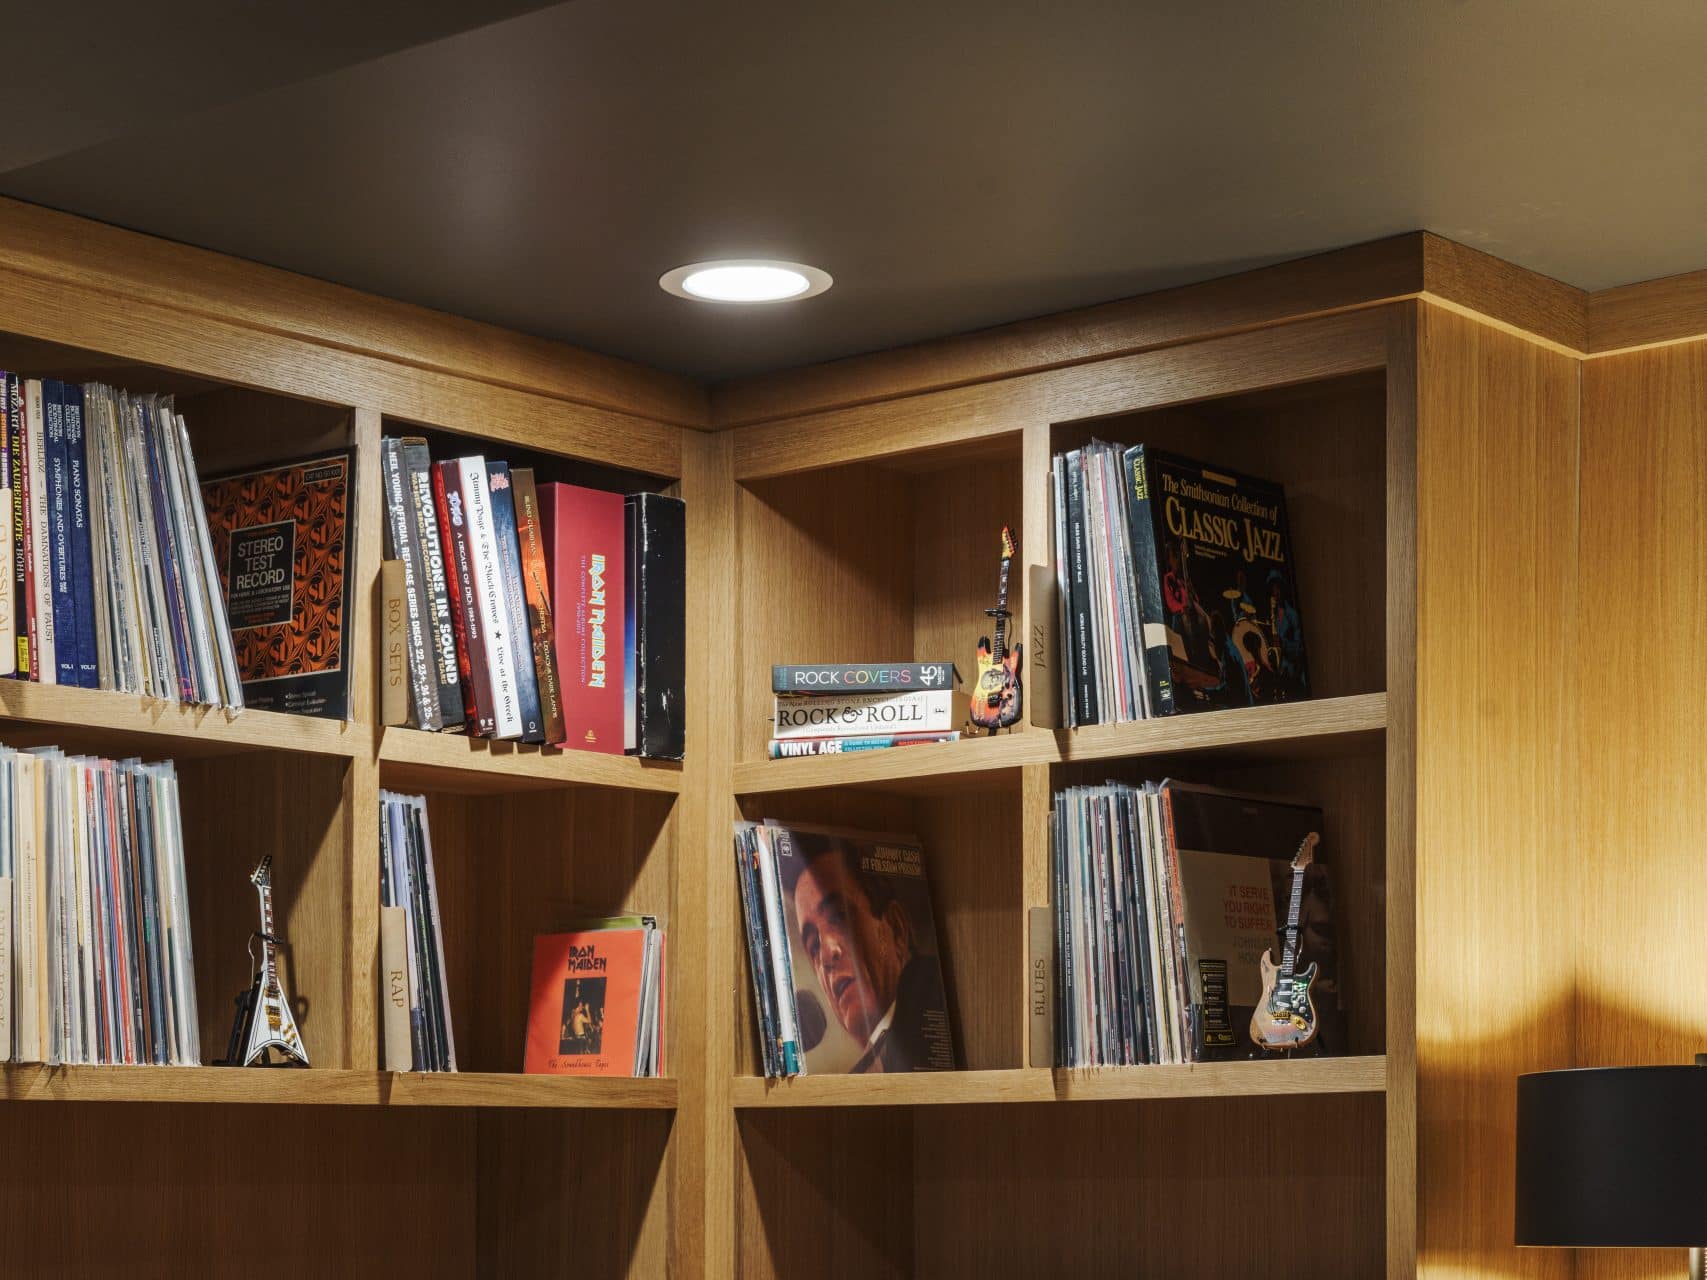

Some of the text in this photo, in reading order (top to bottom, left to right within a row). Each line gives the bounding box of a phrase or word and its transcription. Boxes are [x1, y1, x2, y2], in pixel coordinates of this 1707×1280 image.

[389, 451, 398, 472] NEIL
[10, 384, 25, 582] MOZART DIE ZAUBERFLÖTE BÖHM
[72, 460, 83, 528] PIANO SONATAS
[391, 472, 401, 503] YOUNG
[469, 472, 482, 505] Jimmy
[524, 495, 532, 518] BLIND
[1162, 473, 1180, 495] The
[1180, 477, 1230, 510] Smithsonian
[1231, 493, 1268, 518] Collection
[1268, 506, 1279, 526] of
[53, 457, 66, 581] SYMPHONIES AND OVERTURES
[395, 505, 408, 544] OFFICIAL
[473, 505, 486, 531] Page
[1165, 495, 1286, 564] CLASSIC JAZZ
[36, 432, 53, 644] BERLIOZ THE DAMNATIONS OF FAUST
[237, 535, 284, 559] STEREO
[527, 519, 537, 556] GUARDIAN
[245, 554, 276, 573] TEST
[457, 540, 468, 572] DECADE
[463, 573, 470, 585] OF
[481, 541, 491, 561] The
[236, 568, 285, 590] RECORD
[401, 546, 414, 586] RELEASE
[417, 472, 458, 685] REVOLUTIONS IN SOUND
[407, 587, 419, 618] SERIES
[429, 602, 438, 626] FIRST
[489, 590, 500, 624] Crowes
[411, 621, 423, 647] DISCS
[587, 554, 606, 688] IRON MAIDEN
[389, 599, 402, 687] BOX SETS
[433, 629, 442, 653] FIFTY
[1034, 625, 1048, 669] JAZZ
[496, 646, 506, 666] Live
[437, 658, 446, 685] YEARS
[500, 668, 507, 678] at
[547, 674, 556, 693] DARK
[795, 668, 913, 686] ROCK COVERS
[502, 680, 510, 693] the
[503, 695, 514, 722] Greek
[837, 697, 861, 706] STONE
[778, 704, 924, 728] ROCK & ROLL
[780, 742, 816, 757] VINYL
[819, 741, 844, 755] AGE
[1229, 885, 1237, 898] IT
[1223, 899, 1273, 915] YOU RIGHT
[1224, 915, 1273, 931] TO SUFFER
[567, 957, 608, 974] MAIDEN
[569, 944, 596, 961] IRON
[391, 970, 404, 1008] RAP
[1034, 959, 1046, 1016] BLUES
